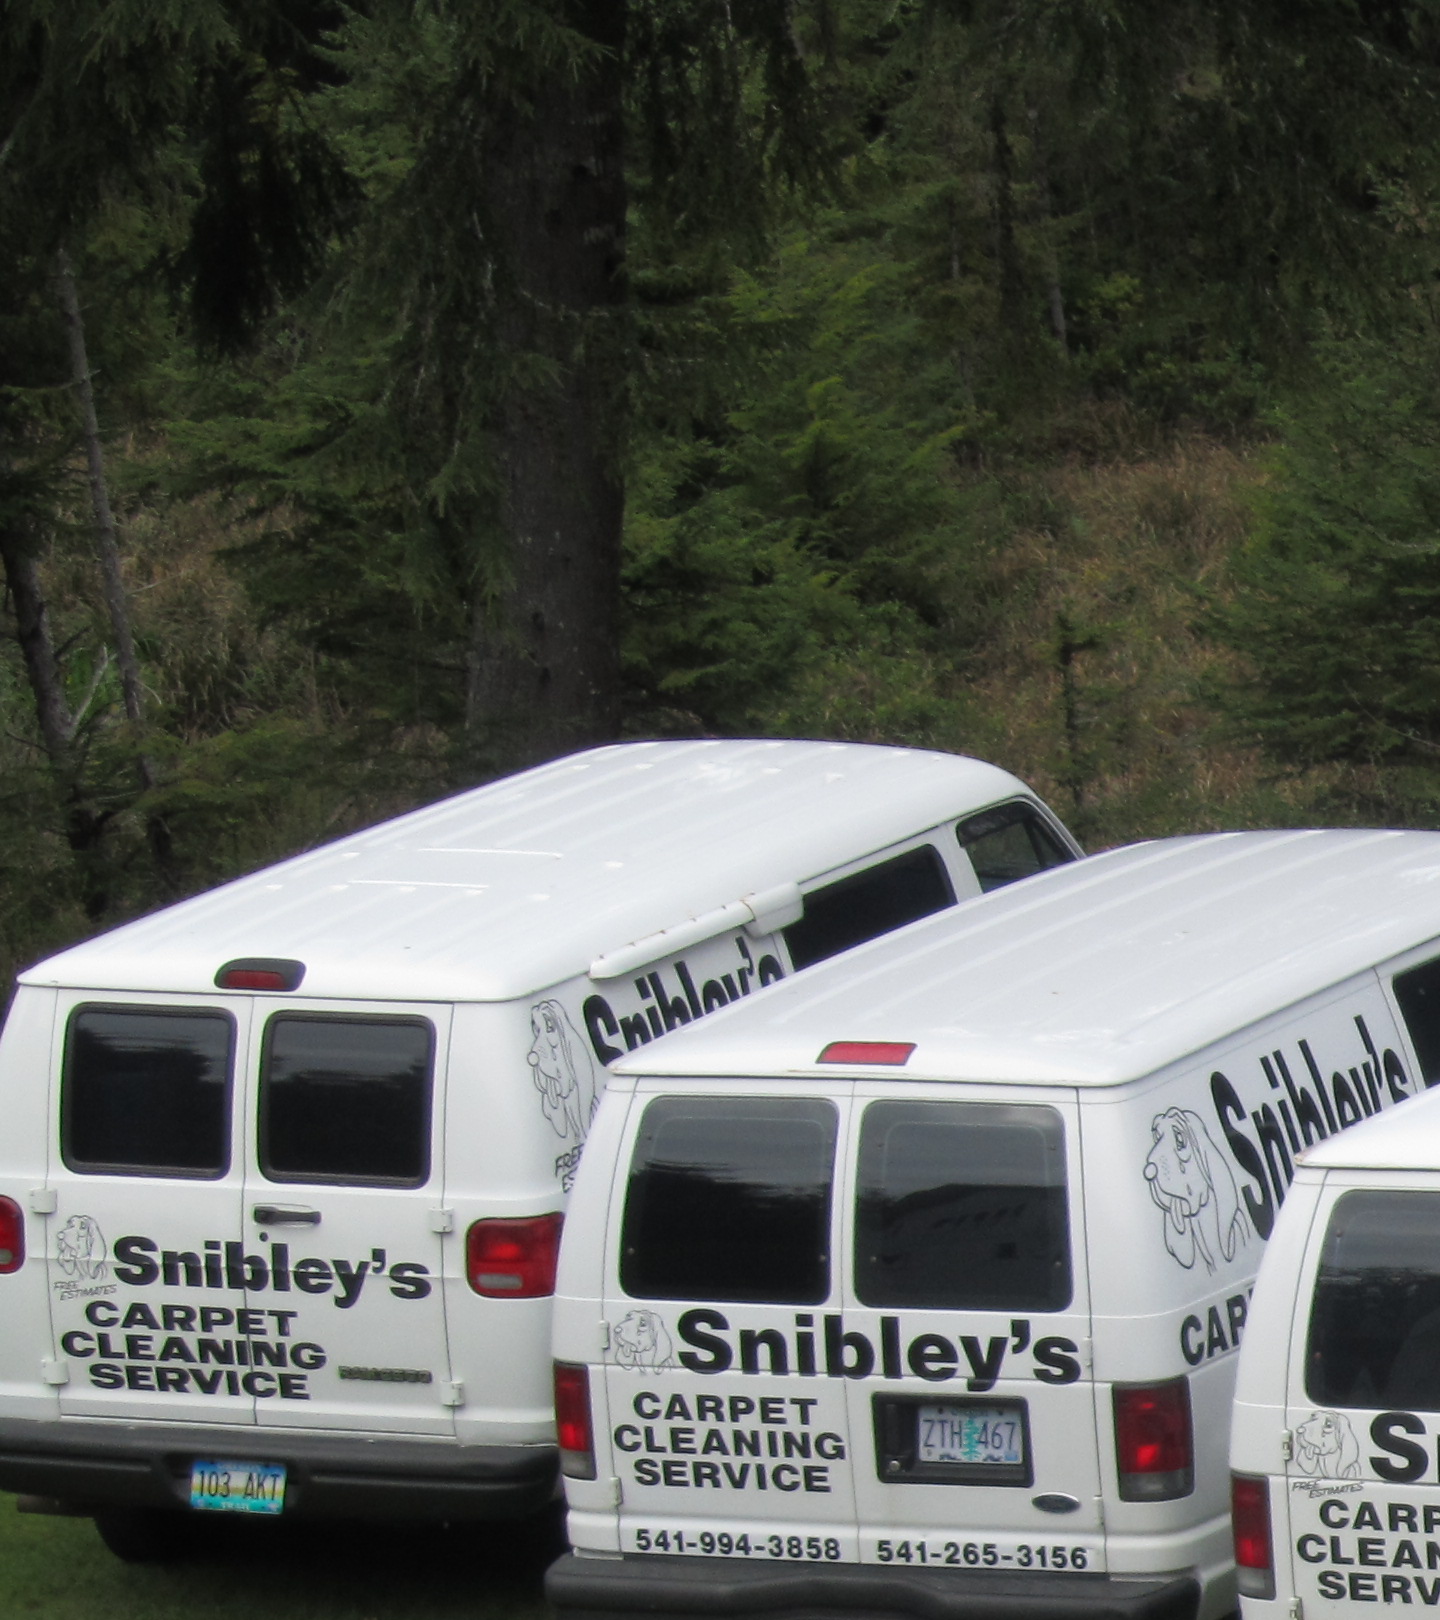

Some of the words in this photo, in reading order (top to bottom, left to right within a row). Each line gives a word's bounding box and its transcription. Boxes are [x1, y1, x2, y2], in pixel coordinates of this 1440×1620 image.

[113, 1236, 431, 1308] Snibley's
[60, 1284, 117, 1300] ESTIMATES
[85, 1300, 298, 1337] CARPET
[61, 1331, 326, 1369] CLEANING
[677, 1309, 1081, 1391] Snibley's
[89, 1363, 310, 1399] SERVICE
[633, 1391, 818, 1426] CARPET
[613, 1425, 845, 1461] CLEANING
[923, 1419, 963, 1449] ZTH
[977, 1421, 1016, 1451] 467
[200, 1470, 230, 1498] 103
[243, 1471, 280, 1501] AKT
[634, 1459, 831, 1492] SERVICE
[1292, 1479, 1321, 1492] FREE
[1309, 1482, 1365, 1499] ESTIMATES
[636, 1529, 840, 1560] 541-994-3858
[877, 1540, 1088, 1570] 541-265-3156
